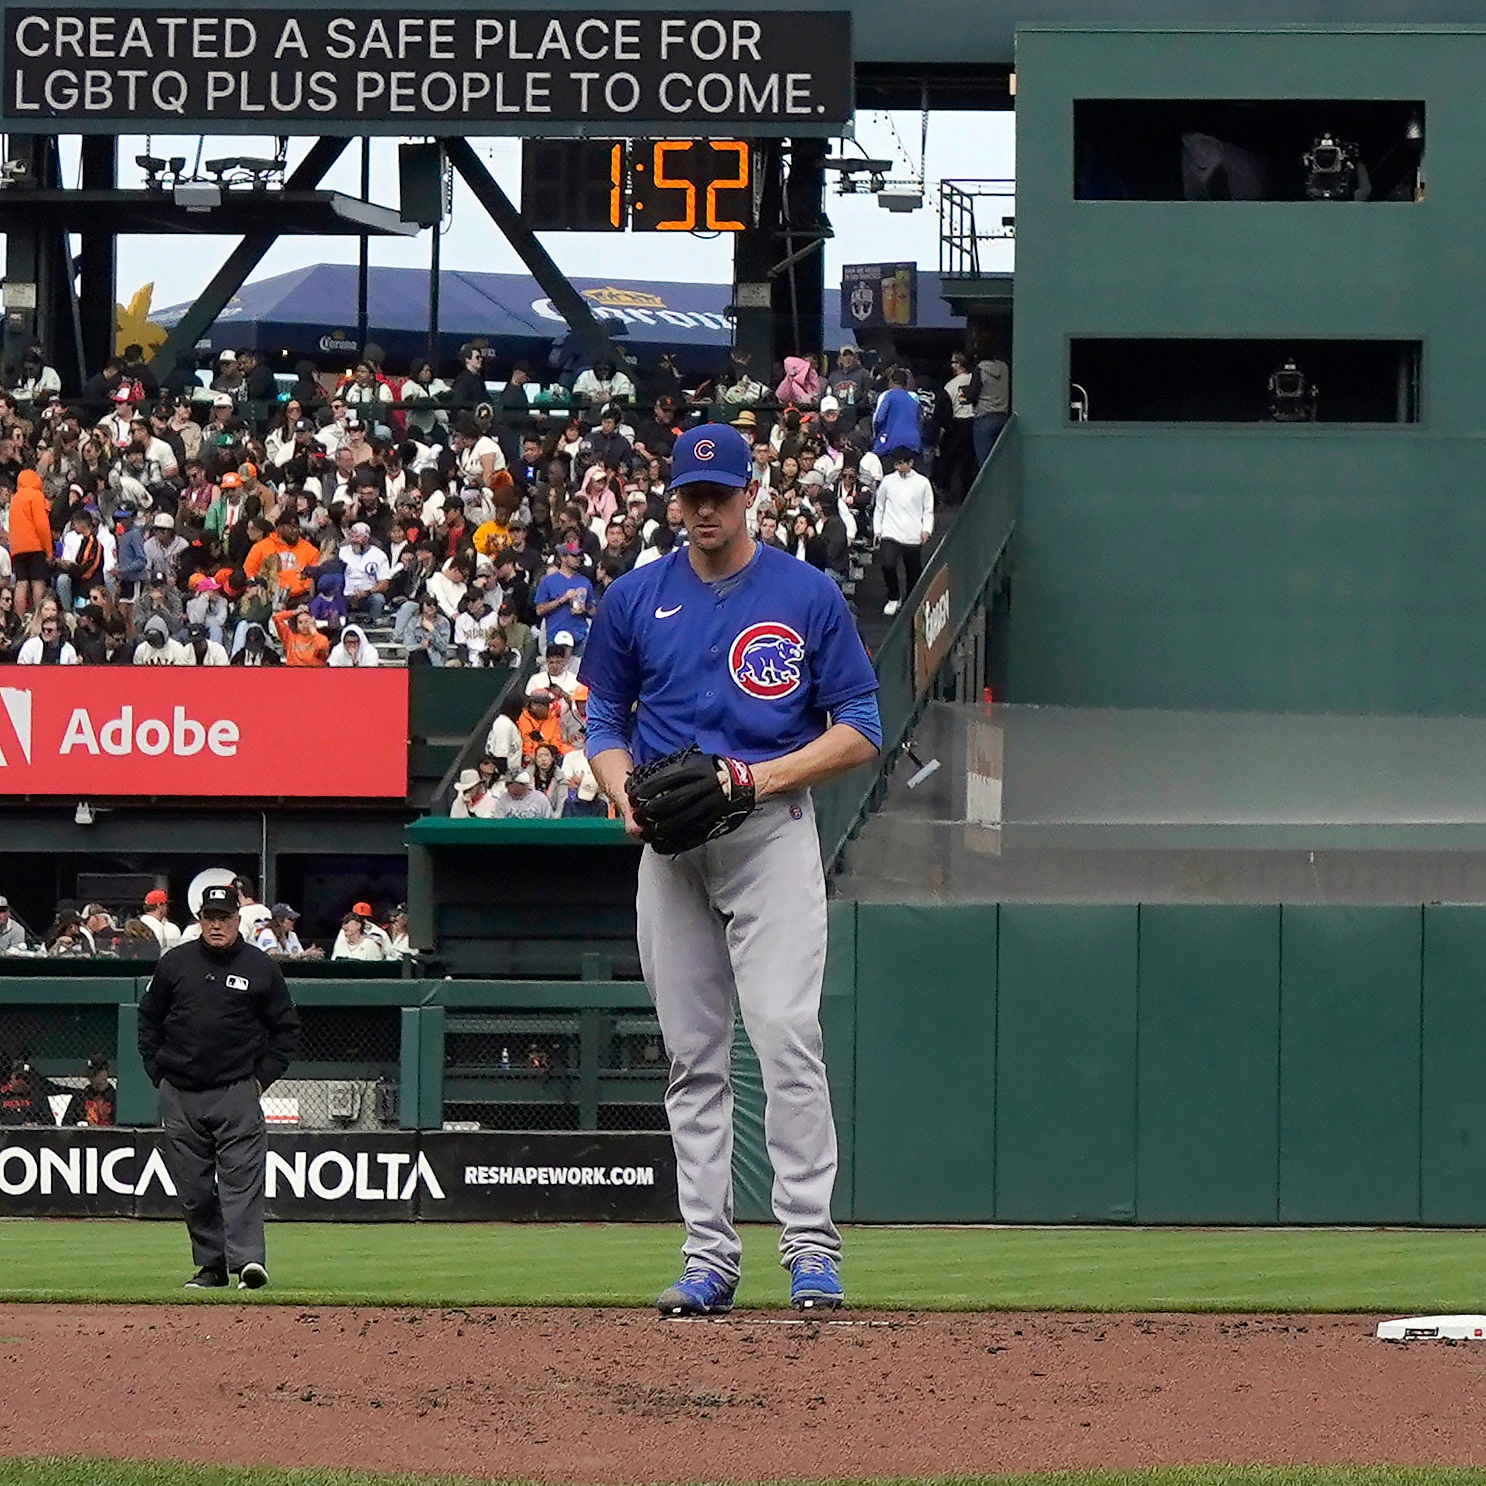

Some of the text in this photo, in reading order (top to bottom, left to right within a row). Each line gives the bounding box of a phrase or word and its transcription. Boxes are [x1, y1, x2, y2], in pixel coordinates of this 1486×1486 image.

[15, 16, 762, 61] CREATED A SAFE PLACE FOR
[15, 69, 825, 116] LGBTQ PLUS PEOPLE TO COME.
[610, 140, 749, 231] 1:52
[59, 705, 240, 758] Adobe
[464, 1165, 655, 1186] RESHAPEWORK.COM
